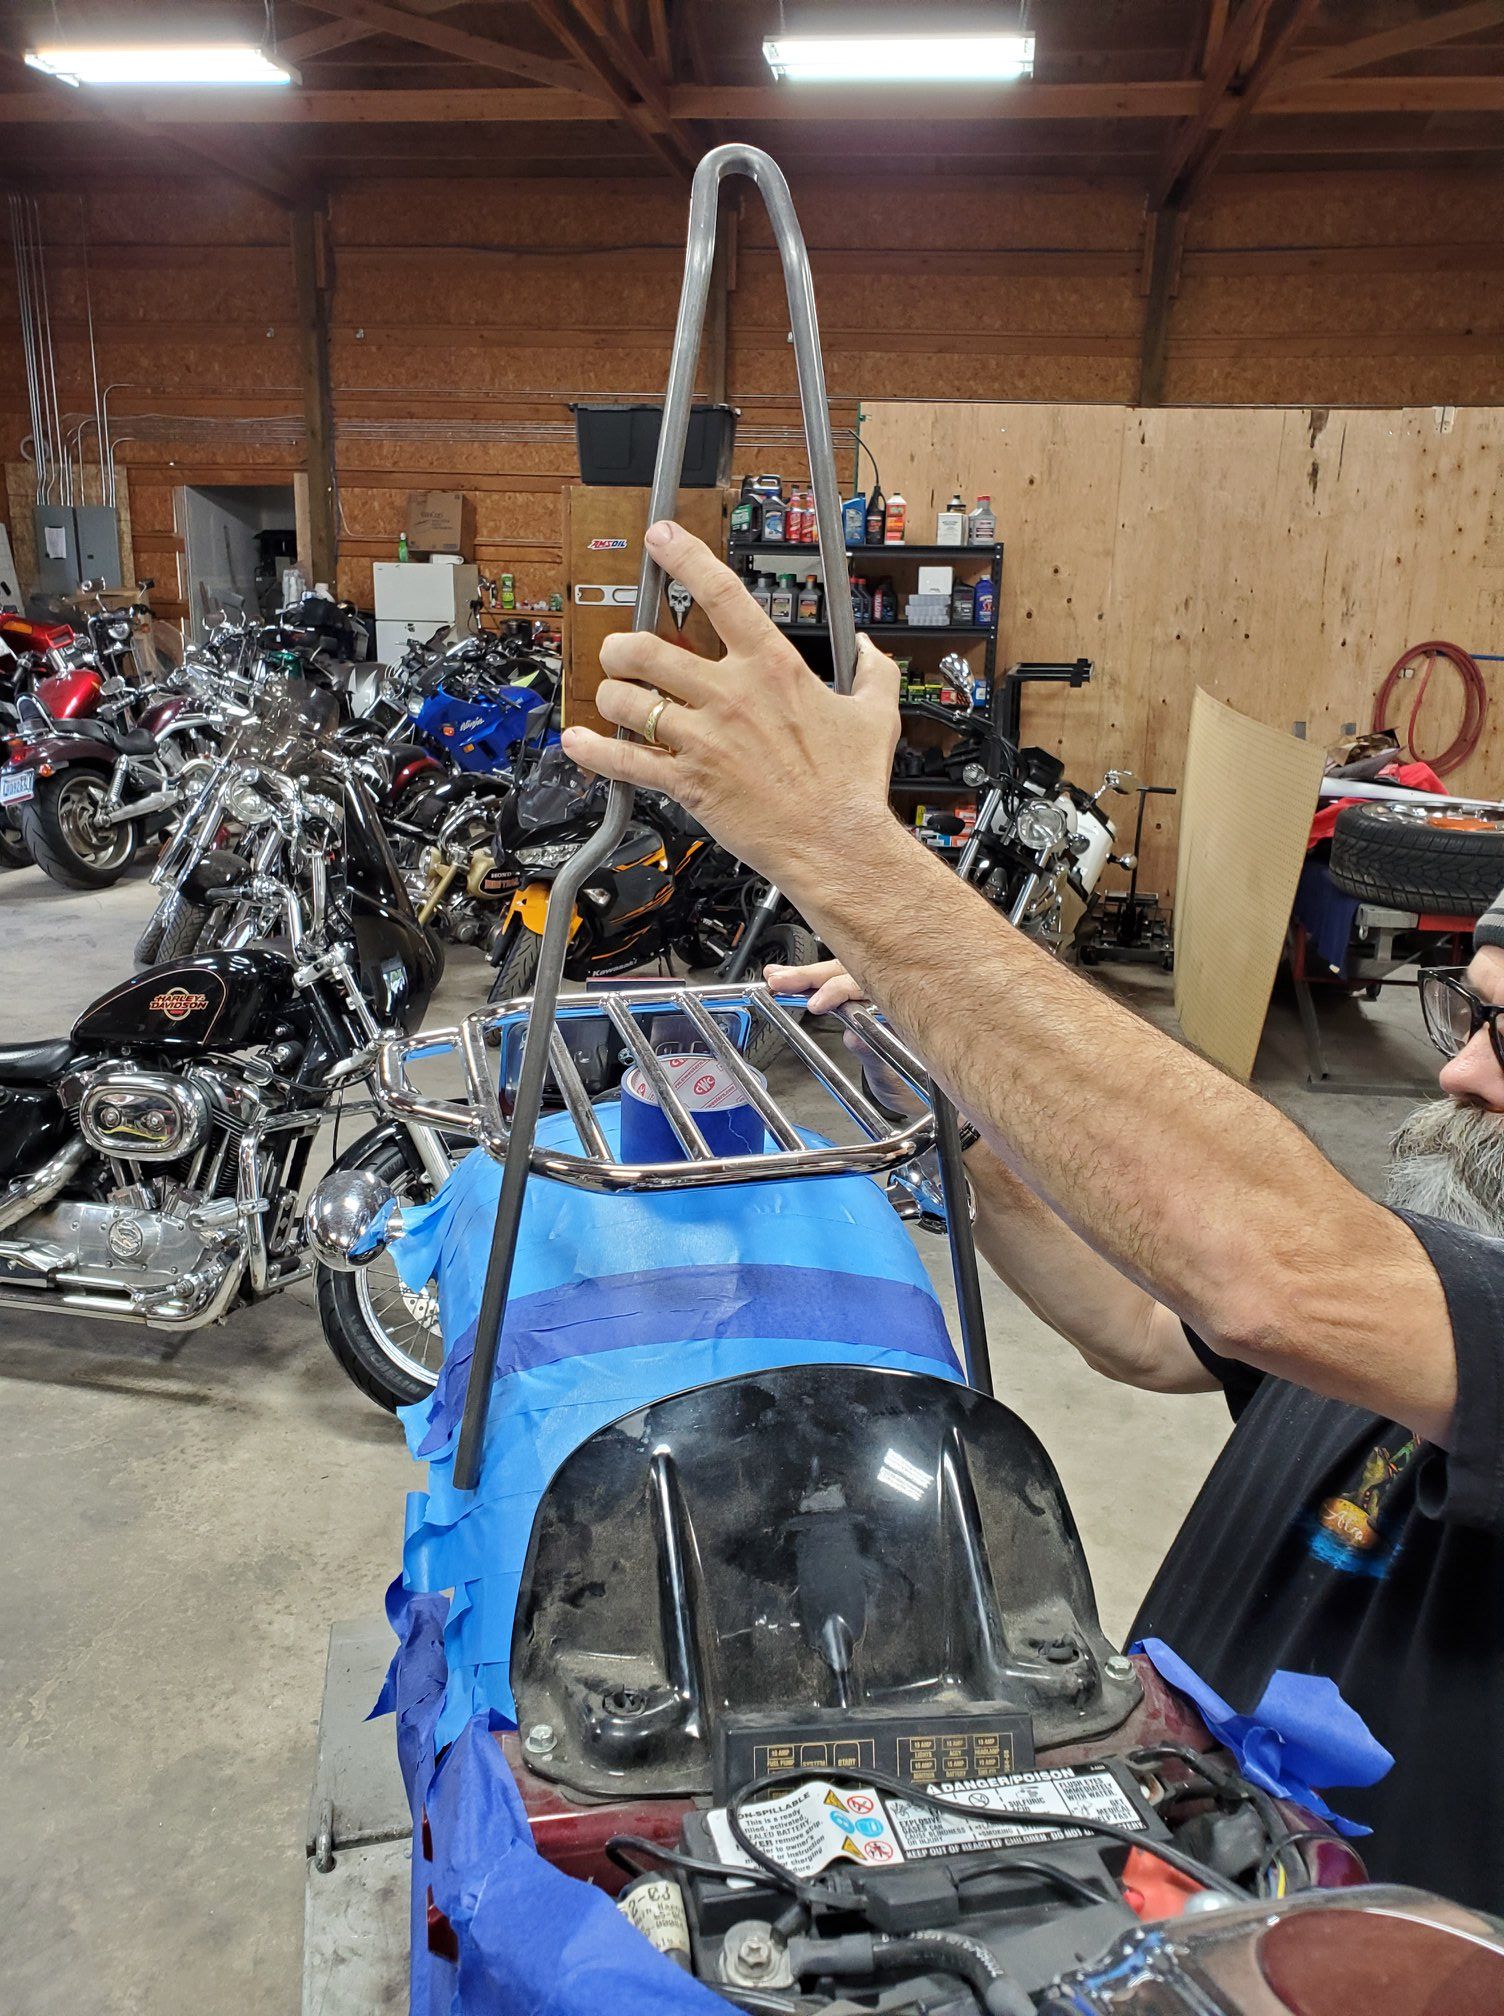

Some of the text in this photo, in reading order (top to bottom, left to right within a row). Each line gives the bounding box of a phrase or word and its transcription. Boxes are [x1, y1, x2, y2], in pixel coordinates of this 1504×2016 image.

[590, 540, 626, 549] AMSOIL
[874, 594, 882, 619] MOTUL
[460, 716, 484, 731] Ninja
[593, 957, 637, 977] Kawasaki
[149, 1001, 209, 1010] DAVIDSON
[695, 1076, 714, 1094] CWC
[356, 1334, 421, 1394] MICHELIN
[942, 1767, 1076, 1792] DANGER/POISON
[1059, 1780, 1083, 1790] FLUSH
[1063, 1783, 1114, 1795] IMMEDIATELY
[737, 1792, 811, 1819] ON-SPILLABLE
[1008, 1797, 1046, 1808] SULFURIC
[1096, 1805, 1130, 1815] MEDICAL
[746, 1817, 762, 1827] This
[780, 1808, 801, 1821] ready
[899, 1816, 941, 1828] EXPLOSIVE
[748, 1831, 775, 1840] EALED
[775, 1833, 804, 1844] remove
[928, 1827, 966, 1837] BLINDNESS
[982, 1827, 1013, 1837] SMOKING
[785, 1835, 814, 1851] owner's
[787, 1835, 825, 1858] instruction
[906, 1848, 928, 1859] KEEP
[929, 1845, 947, 1856] OUT
[948, 1843, 960, 1854] OF
[961, 1840, 991, 1852] REACH
[991, 1838, 1003, 1849] OF
[1050, 1829, 1064, 1840] DO
[1064, 1828, 1082, 1839] NOT
[919, 1836, 943, 1845] INJURY
[791, 1847, 824, 1865] charging
